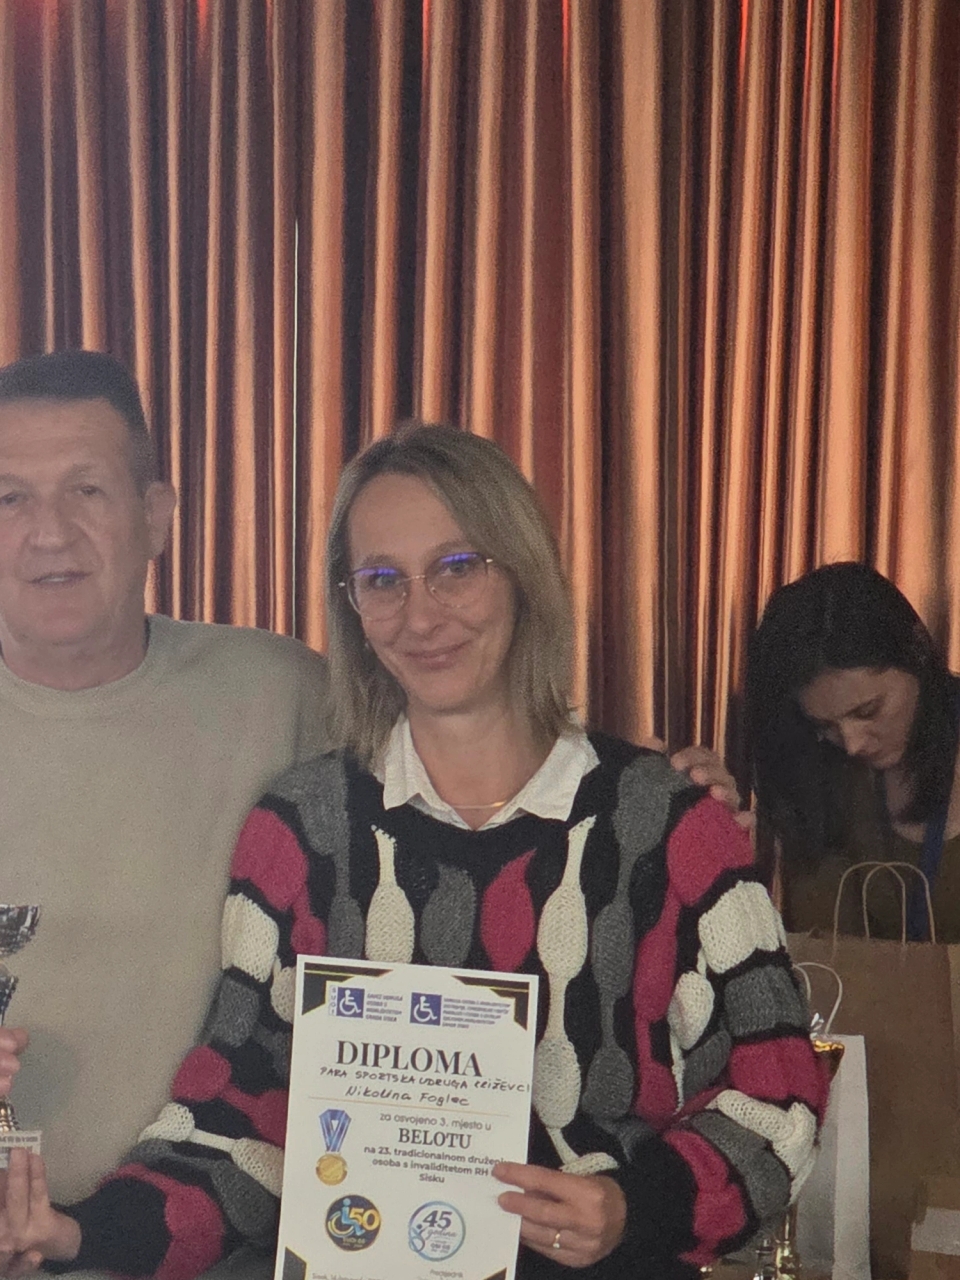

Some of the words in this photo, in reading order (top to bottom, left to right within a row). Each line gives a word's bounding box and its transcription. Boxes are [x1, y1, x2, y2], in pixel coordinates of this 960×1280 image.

[336, 1039, 483, 1077] DIPLOMA
[418, 1077, 469, 1090] UDRUGA
[379, 1113, 391, 1121] za
[394, 1114, 437, 1126] osvojeno
[451, 1118, 483, 1130] mjesto
[485, 1123, 492, 1131] u
[398, 1127, 472, 1149] BELOTU
[364, 1145, 376, 1153] na
[394, 1148, 466, 1162] tradicionalnom
[372, 1157, 401, 1168] osoba
[410, 1160, 472, 1175] invaliditetom
[475, 1167, 489, 1176] RH
[419, 1173, 445, 1183] Sisku
[349, 1207, 381, 1231] 50
[422, 1209, 453, 1229] 45
